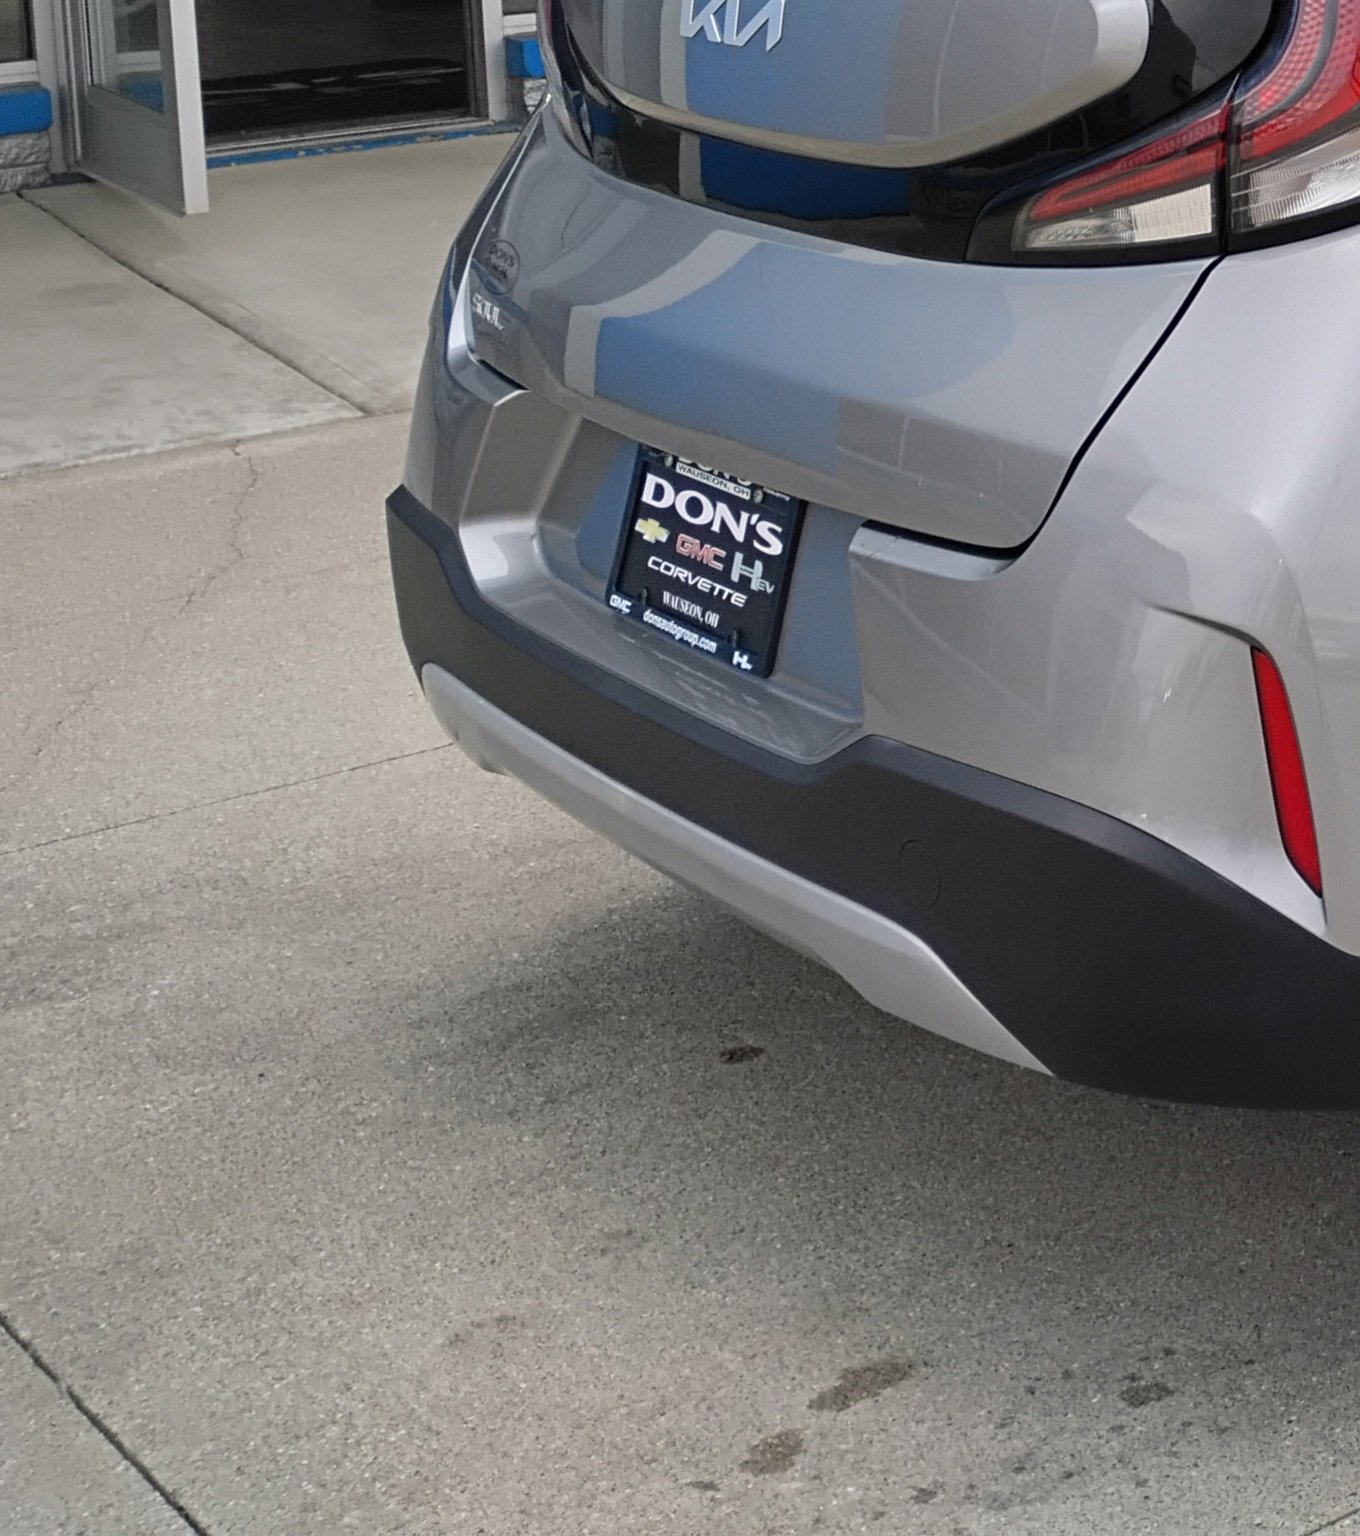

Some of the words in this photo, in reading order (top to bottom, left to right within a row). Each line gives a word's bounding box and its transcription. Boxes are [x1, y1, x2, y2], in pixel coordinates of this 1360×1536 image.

[733, 484, 750, 497] OH
[641, 472, 783, 556] DON'S
[676, 533, 726, 571] GMC
[647, 556, 748, 607] CORVETTE
[609, 594, 633, 614] GMC
[704, 610, 720, 628] OH
[643, 609, 718, 653] donsautogroup.com
